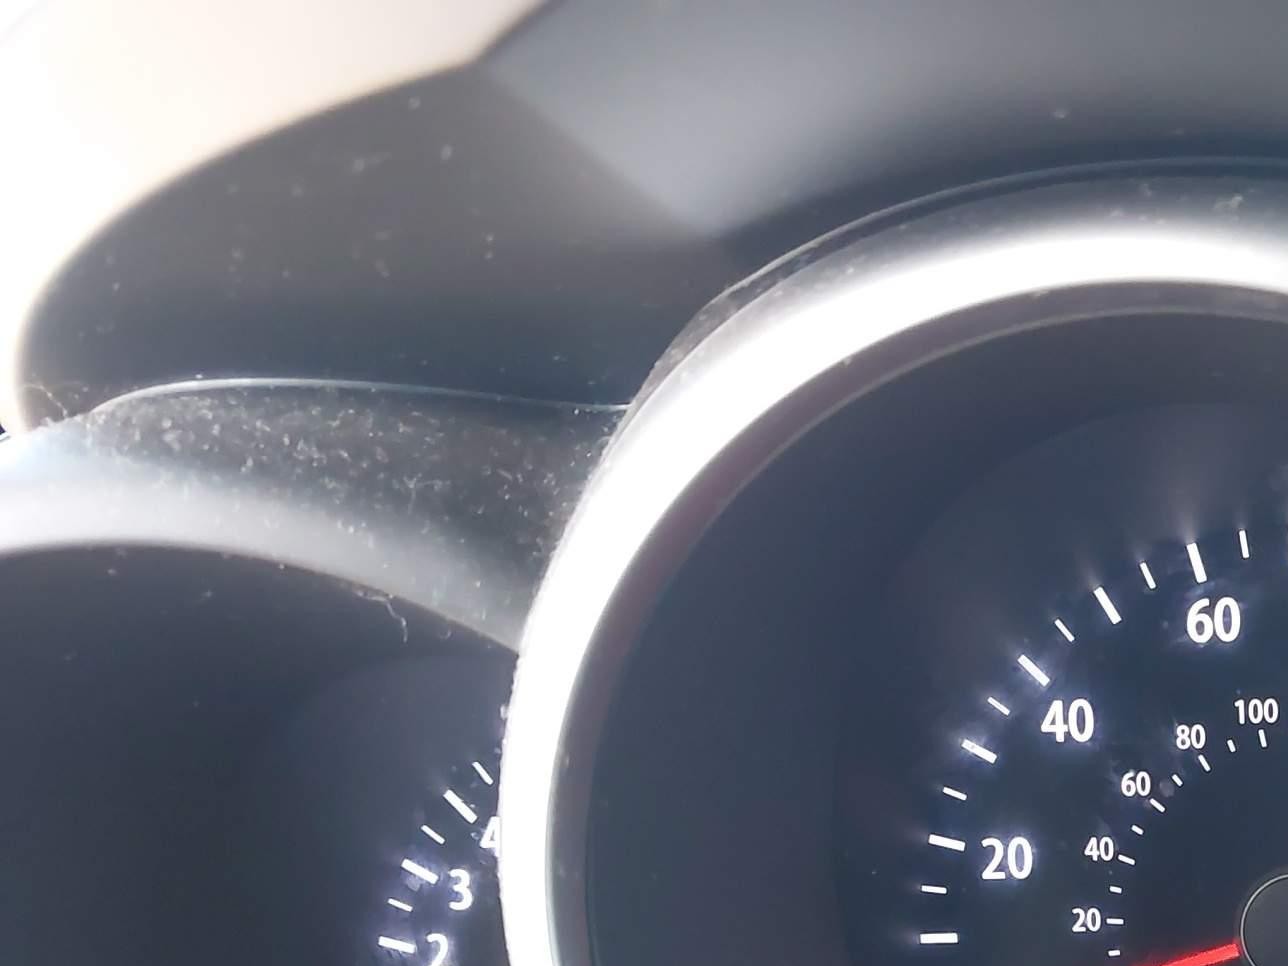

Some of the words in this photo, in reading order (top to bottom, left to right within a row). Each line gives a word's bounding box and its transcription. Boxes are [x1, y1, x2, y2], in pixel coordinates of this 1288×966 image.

[1186, 596, 1241, 644] 60
[1040, 698, 1095, 743] 40
[1234, 698, 1279, 725] 100
[1176, 724, 1206, 750] 80
[1121, 771, 1151, 797] 60
[981, 836, 1033, 880] 20
[1084, 836, 1114, 861] 40
[447, 868, 474, 911] 3
[1071, 907, 1101, 932] 20
